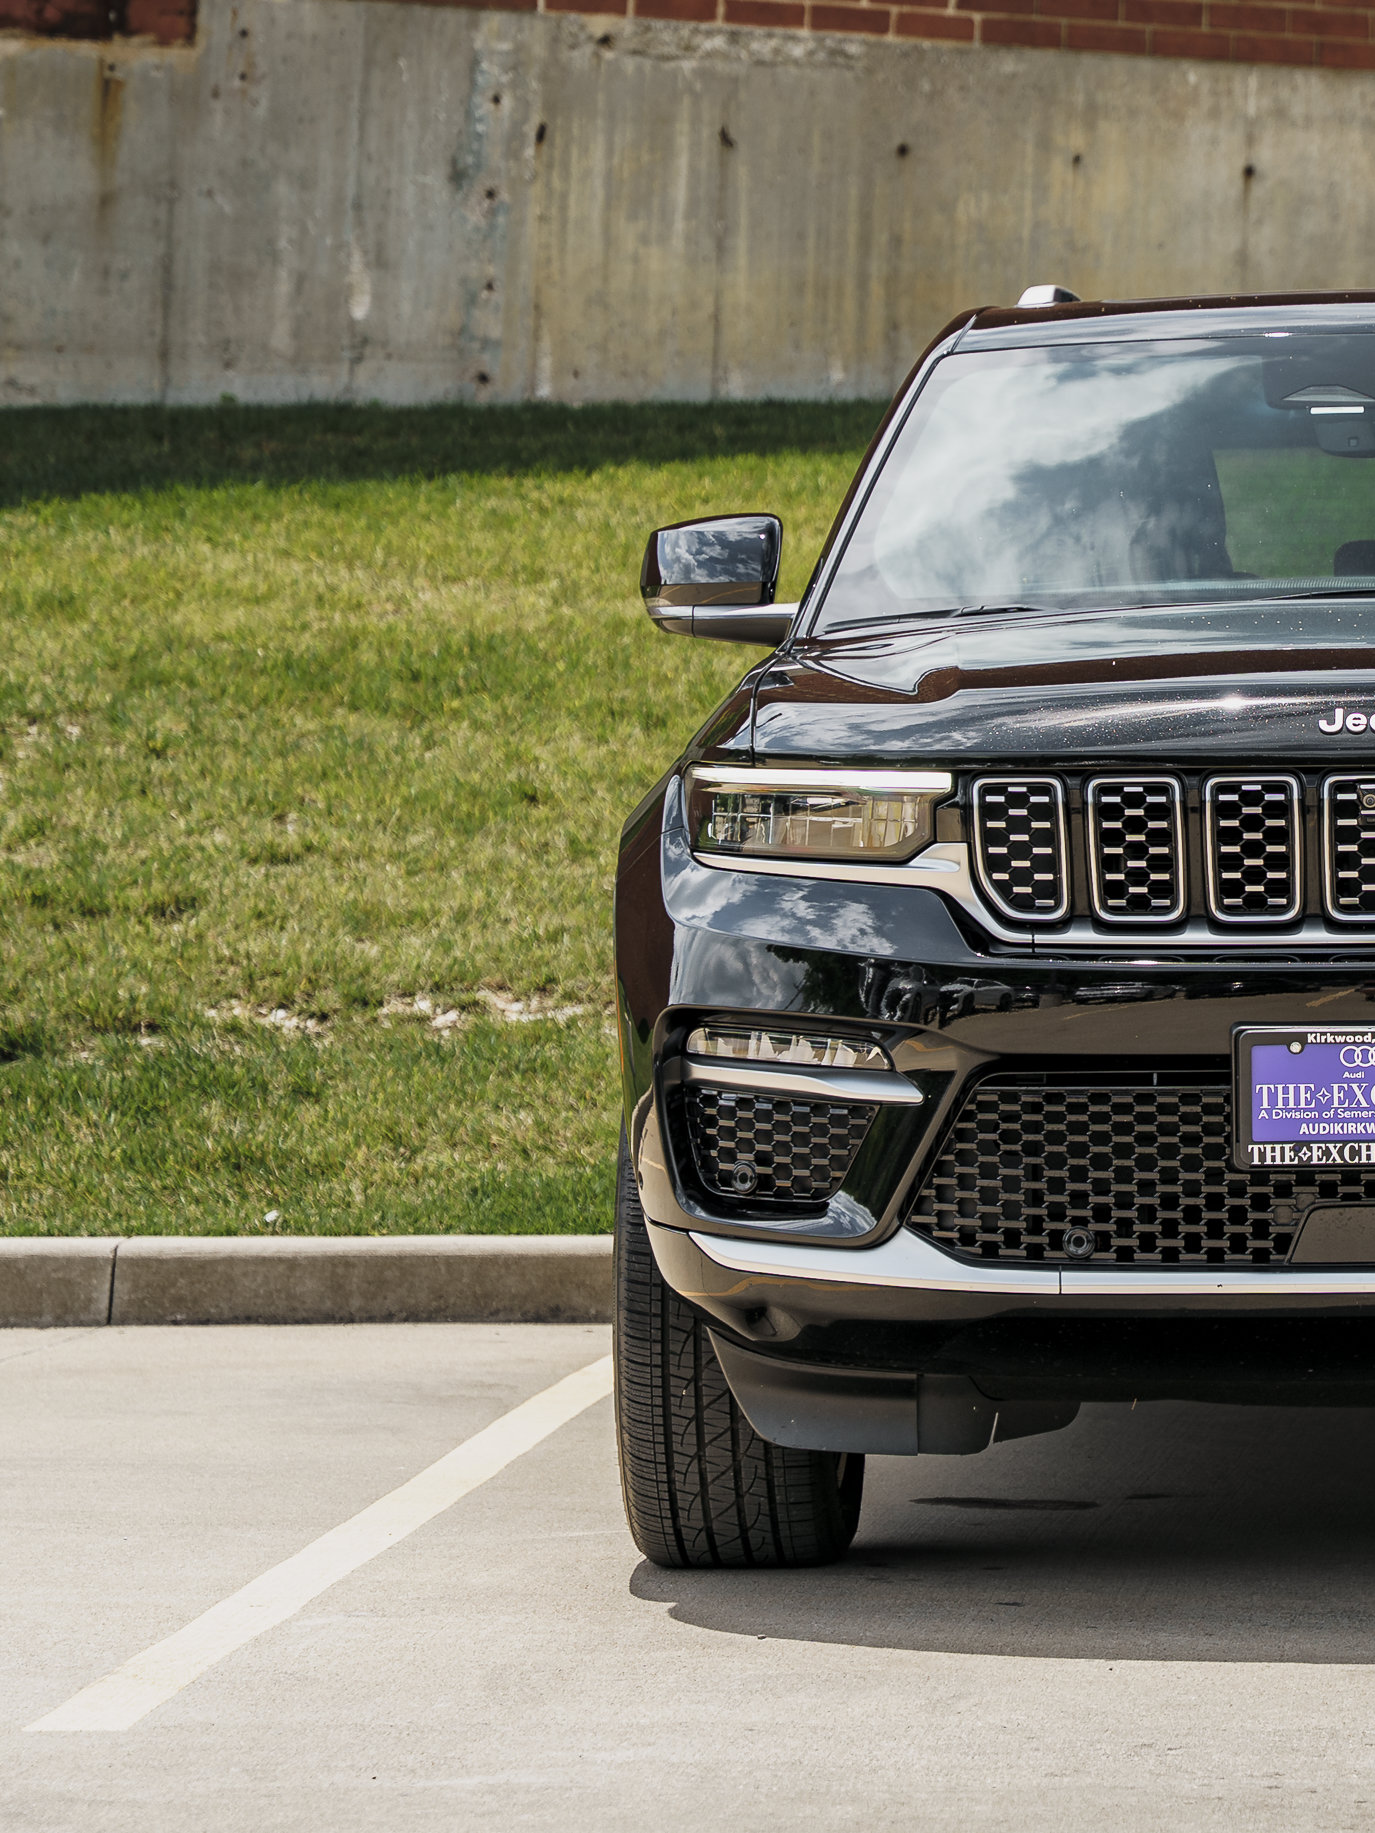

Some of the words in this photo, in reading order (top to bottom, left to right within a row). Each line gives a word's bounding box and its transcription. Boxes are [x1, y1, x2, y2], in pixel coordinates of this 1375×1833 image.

[1307, 1033, 1375, 1044] Kirkwood,
[1342, 1071, 1365, 1079] Audi
[1255, 1083, 1316, 1109] THE
[1258, 1109, 1269, 1119] A
[1272, 1109, 1319, 1119] Division
[1322, 1108, 1335, 1119] of
[1248, 1143, 1299, 1165] THE
